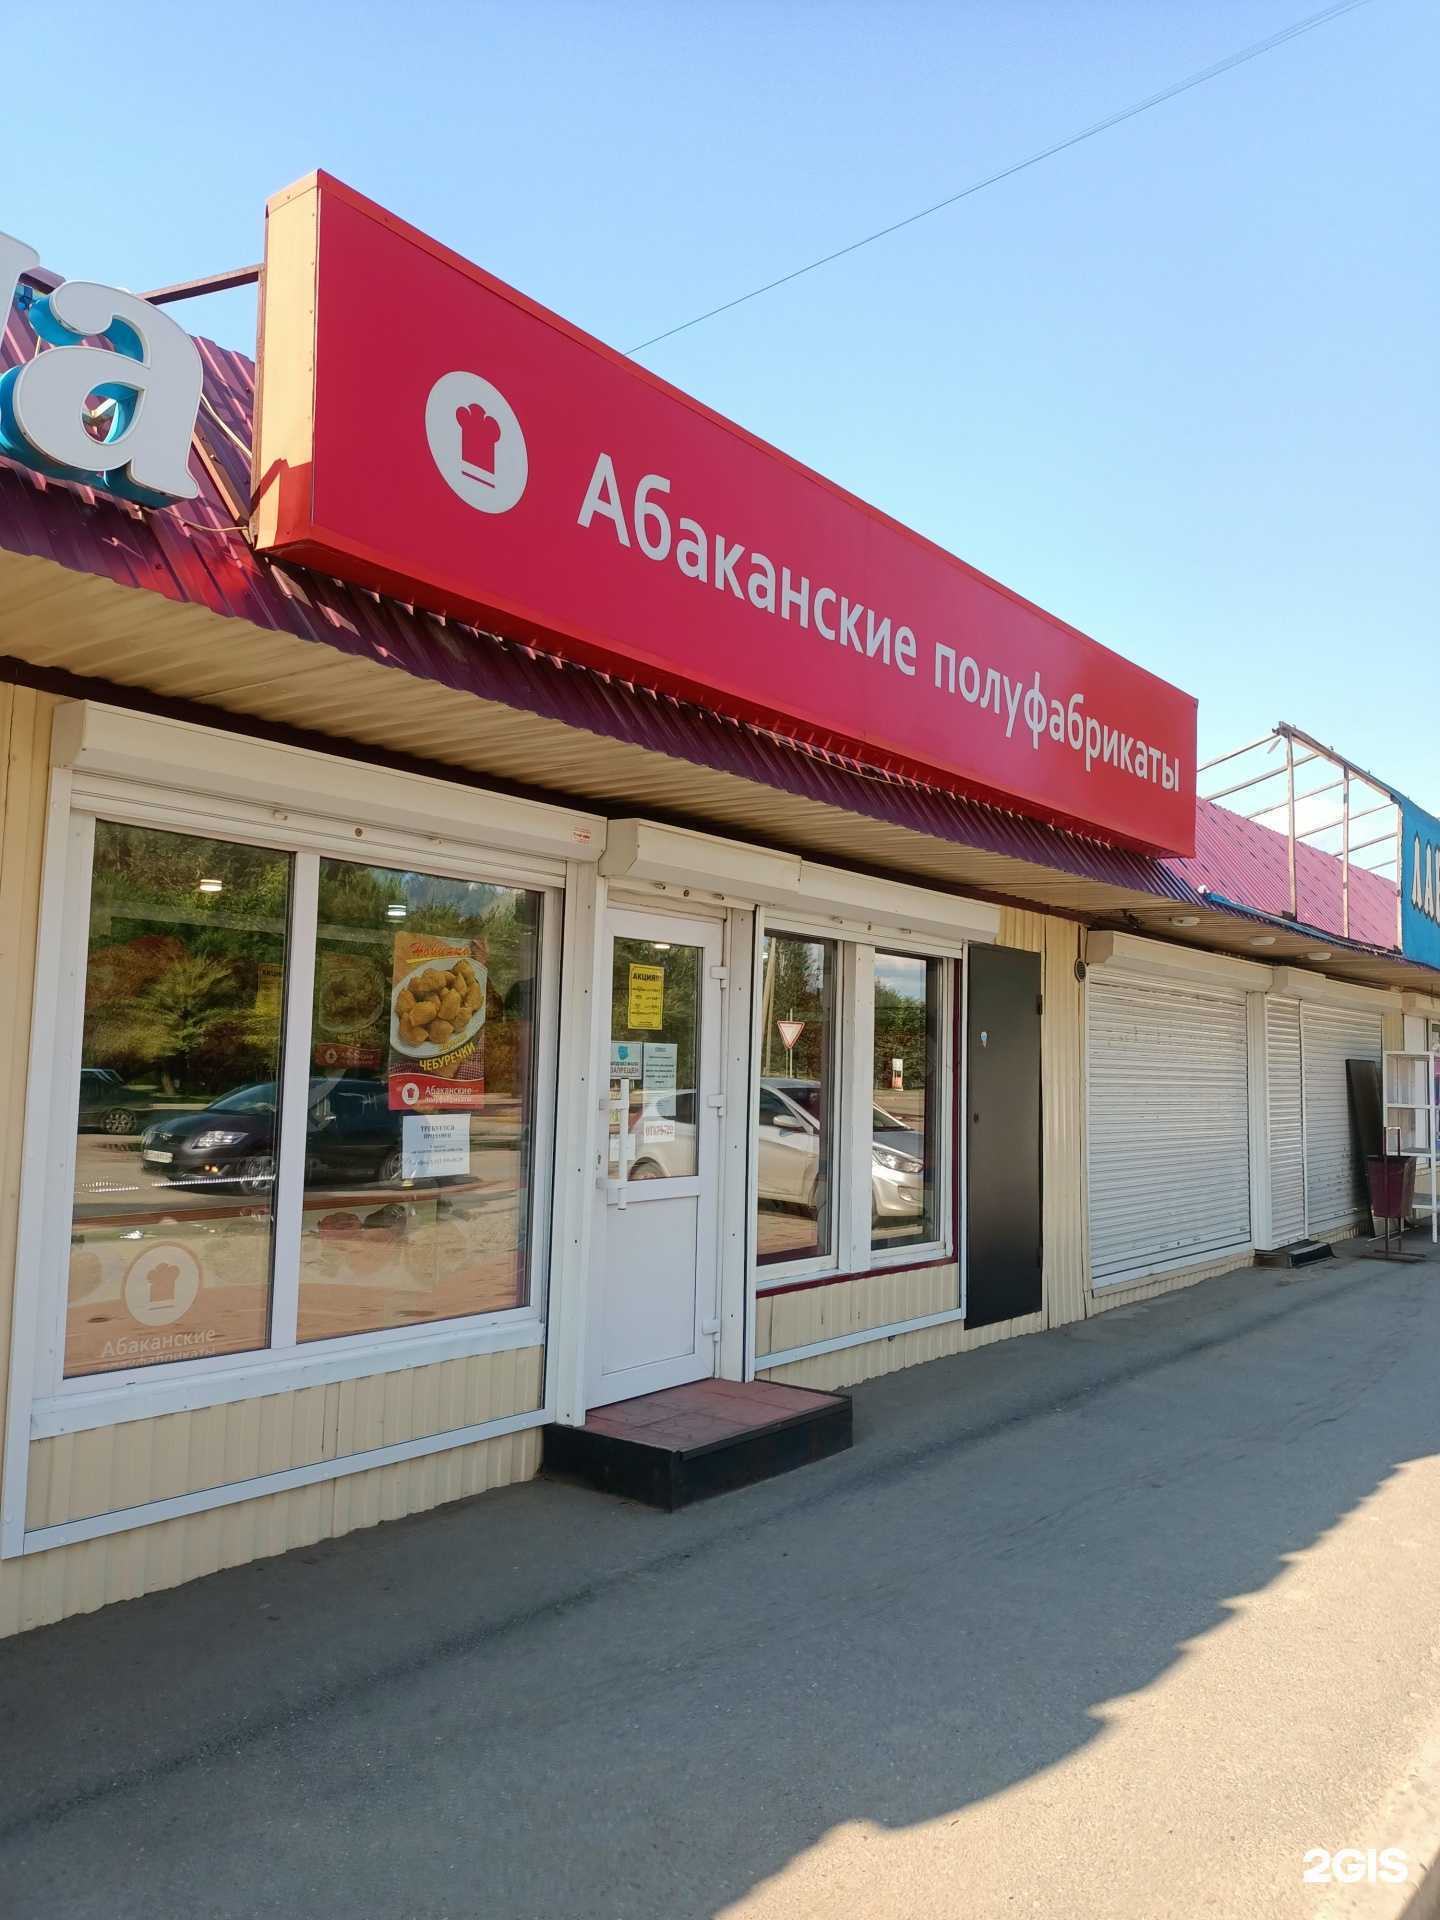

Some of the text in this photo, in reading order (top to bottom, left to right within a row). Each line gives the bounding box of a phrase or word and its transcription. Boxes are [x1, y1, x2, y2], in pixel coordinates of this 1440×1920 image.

[577, 451, 1180, 792] Абаканские полуфабрикаты
[419, 1040, 477, 1071] ЧЕБУРЕЧКИ
[425, 1084, 472, 1095] Абаканские
[102, 1328, 216, 1358] Абаканские
